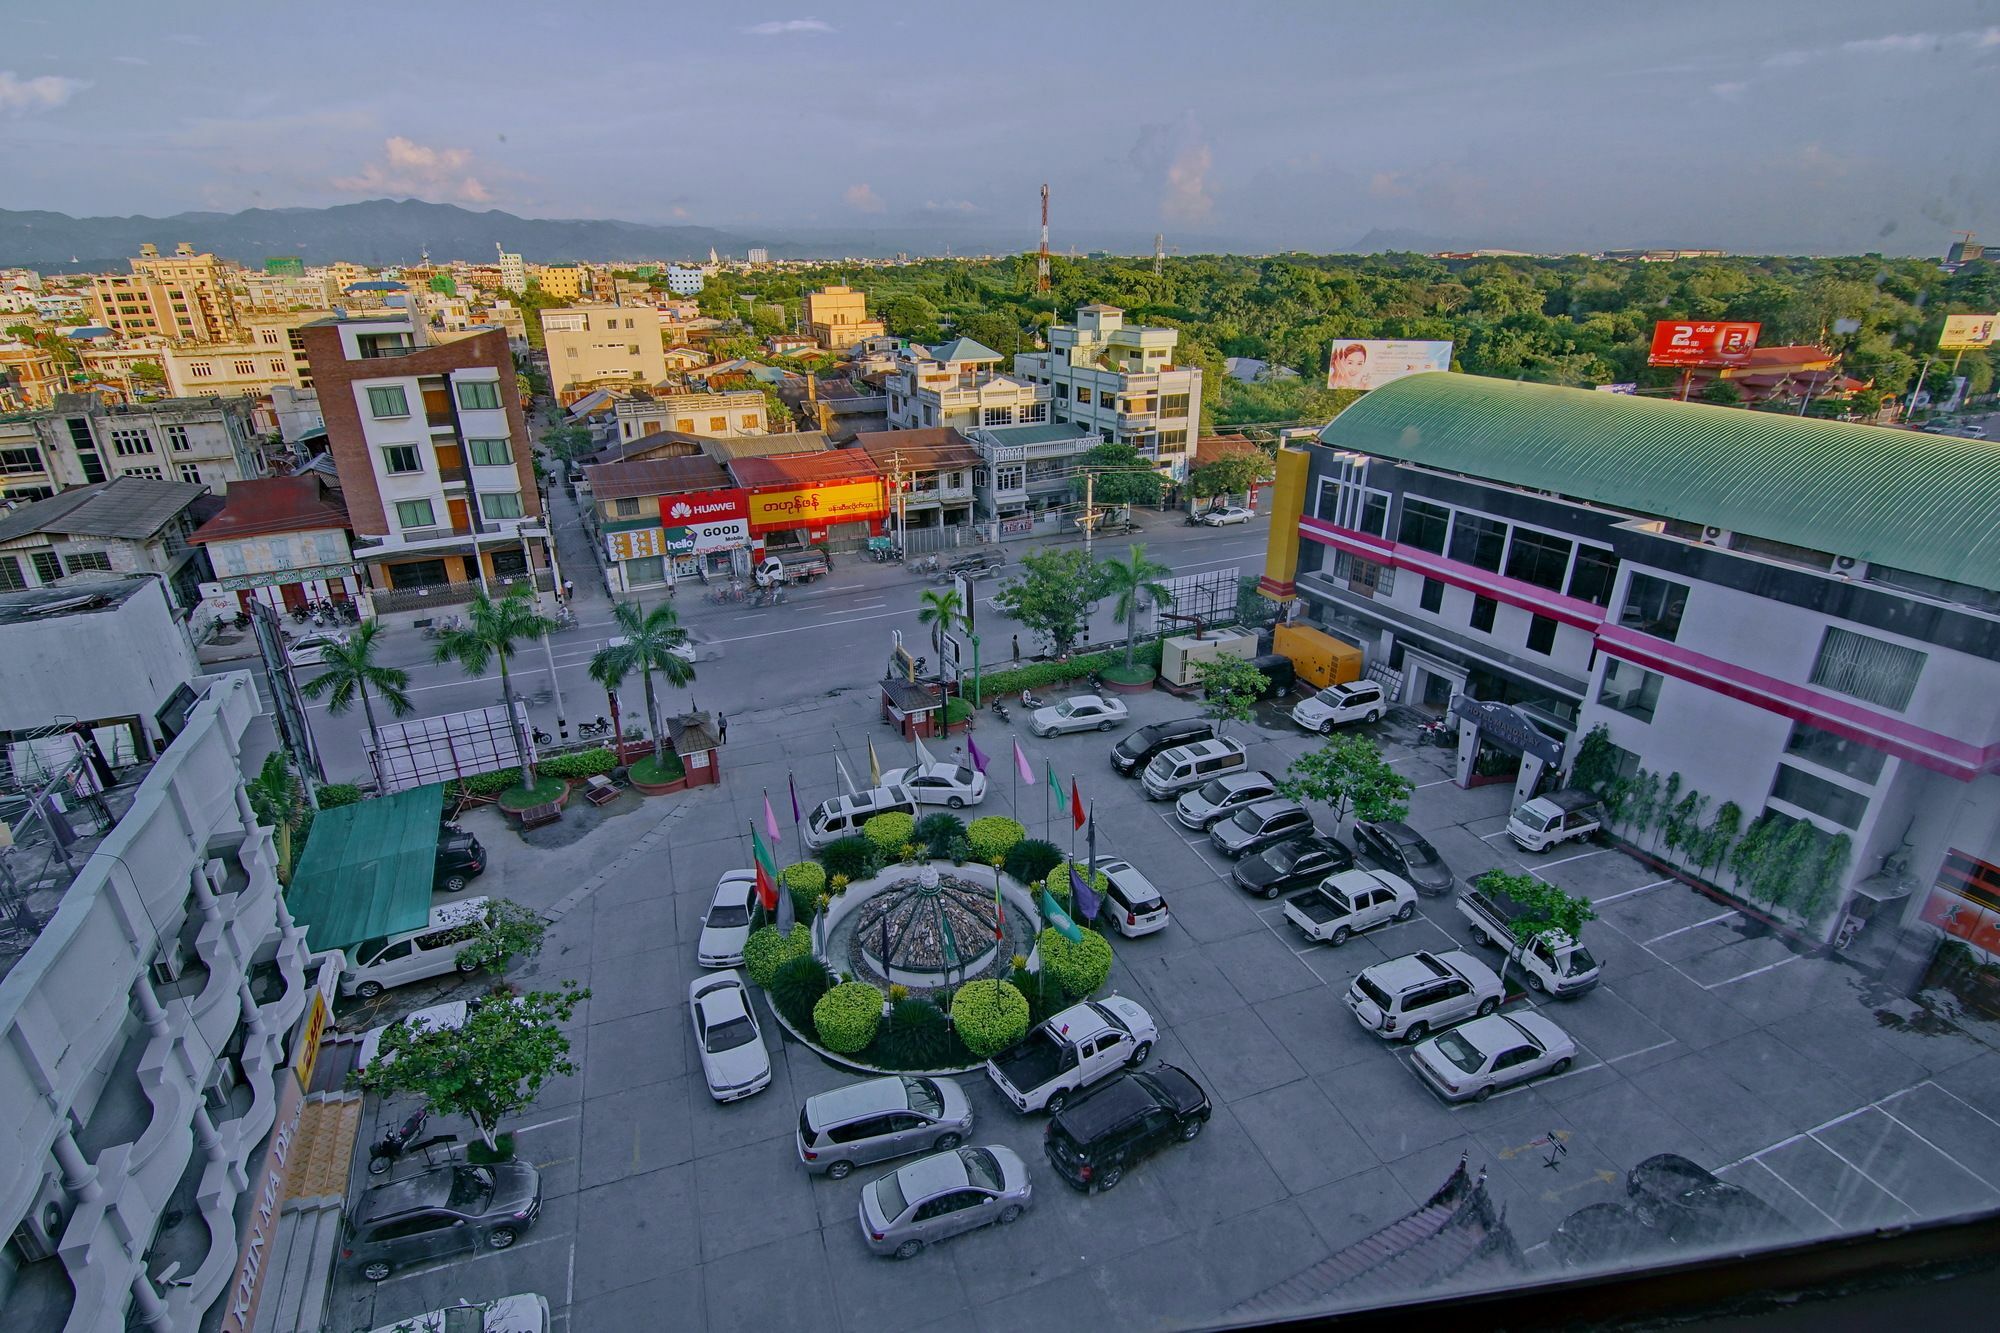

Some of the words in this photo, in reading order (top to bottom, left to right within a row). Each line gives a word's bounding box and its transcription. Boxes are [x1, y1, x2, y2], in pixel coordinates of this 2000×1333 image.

[694, 502, 736, 514] HUAWEI
[704, 525, 740, 537] GOOD
[667, 540, 694, 550] hello
[303, 1005, 322, 1074] DHL
[233, 1225, 264, 1331] KHIN
[259, 1168, 281, 1228] MA
